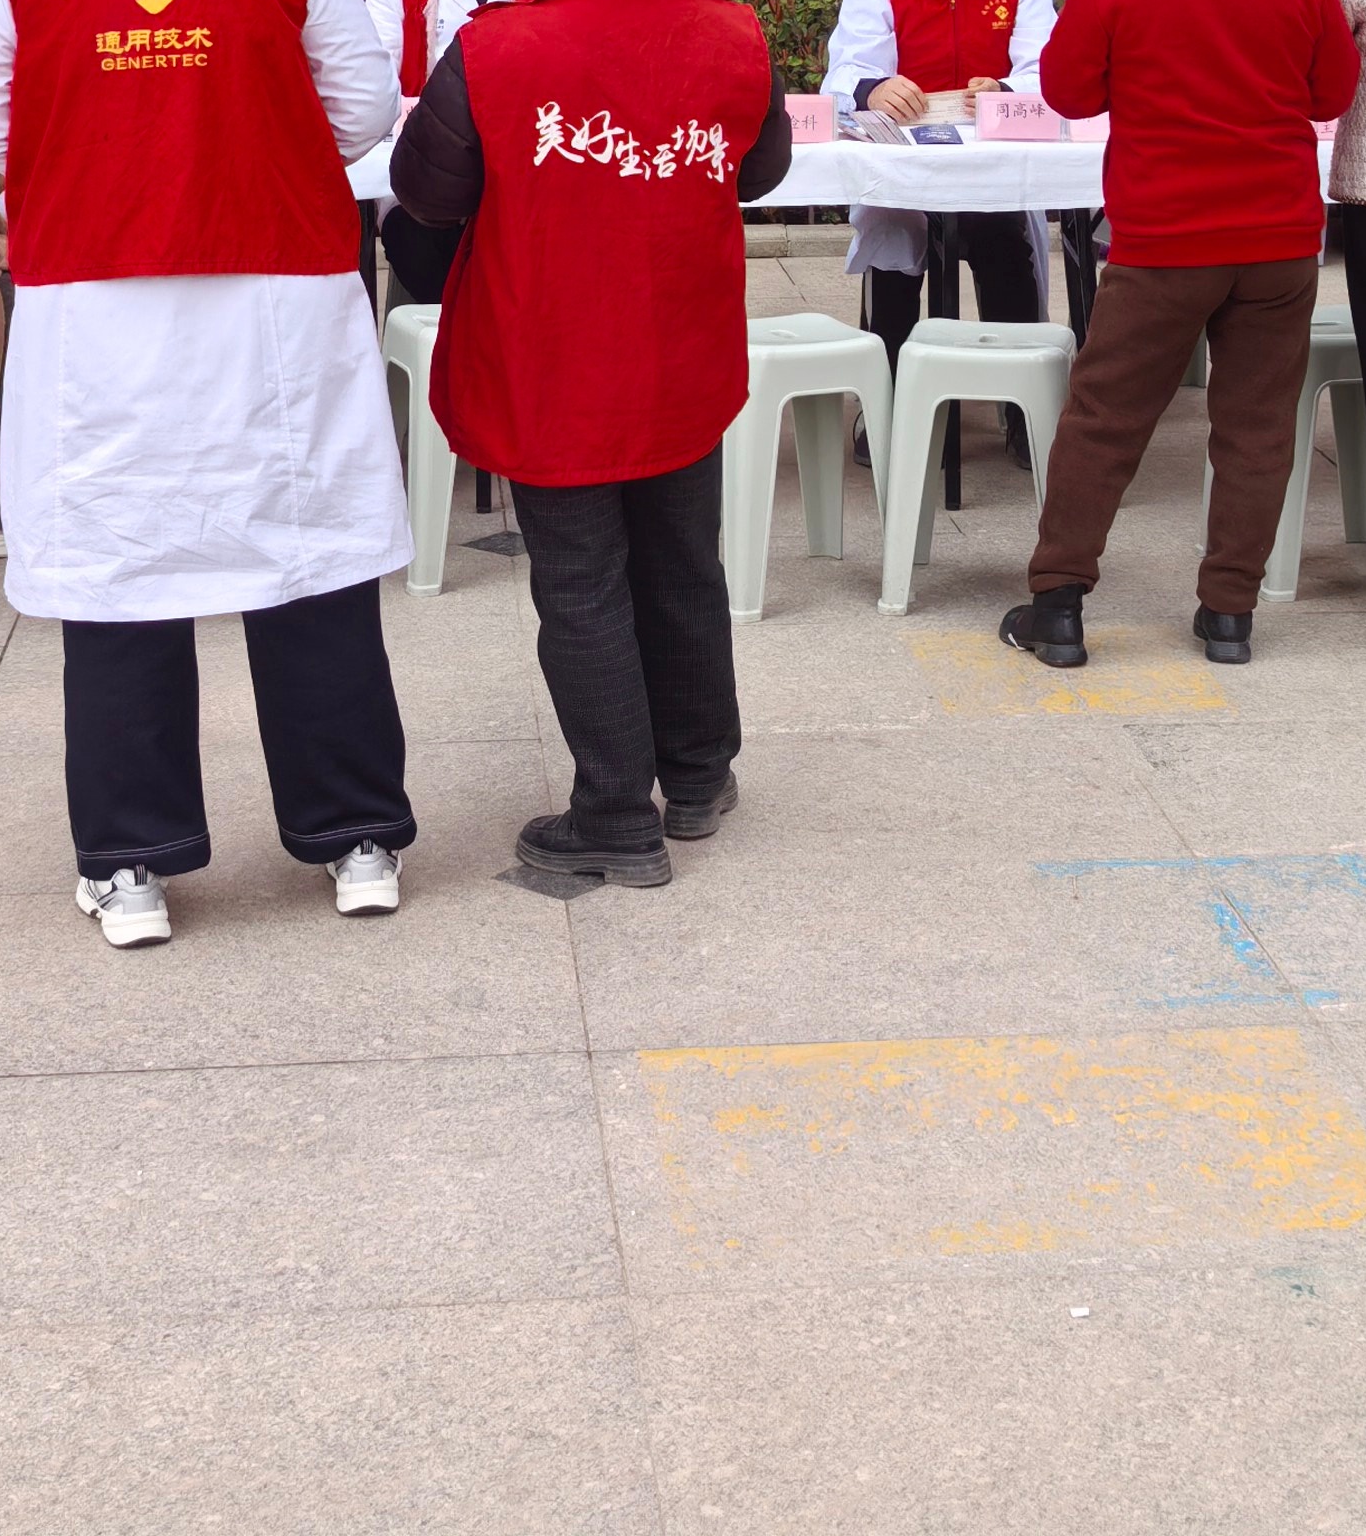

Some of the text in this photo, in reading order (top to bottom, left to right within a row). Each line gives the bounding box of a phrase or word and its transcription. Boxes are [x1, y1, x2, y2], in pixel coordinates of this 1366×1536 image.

[95, 26, 214, 55] 通用技术
[101, 53, 209, 72] GENERTEC
[533, 100, 735, 184] 美好生活场景
